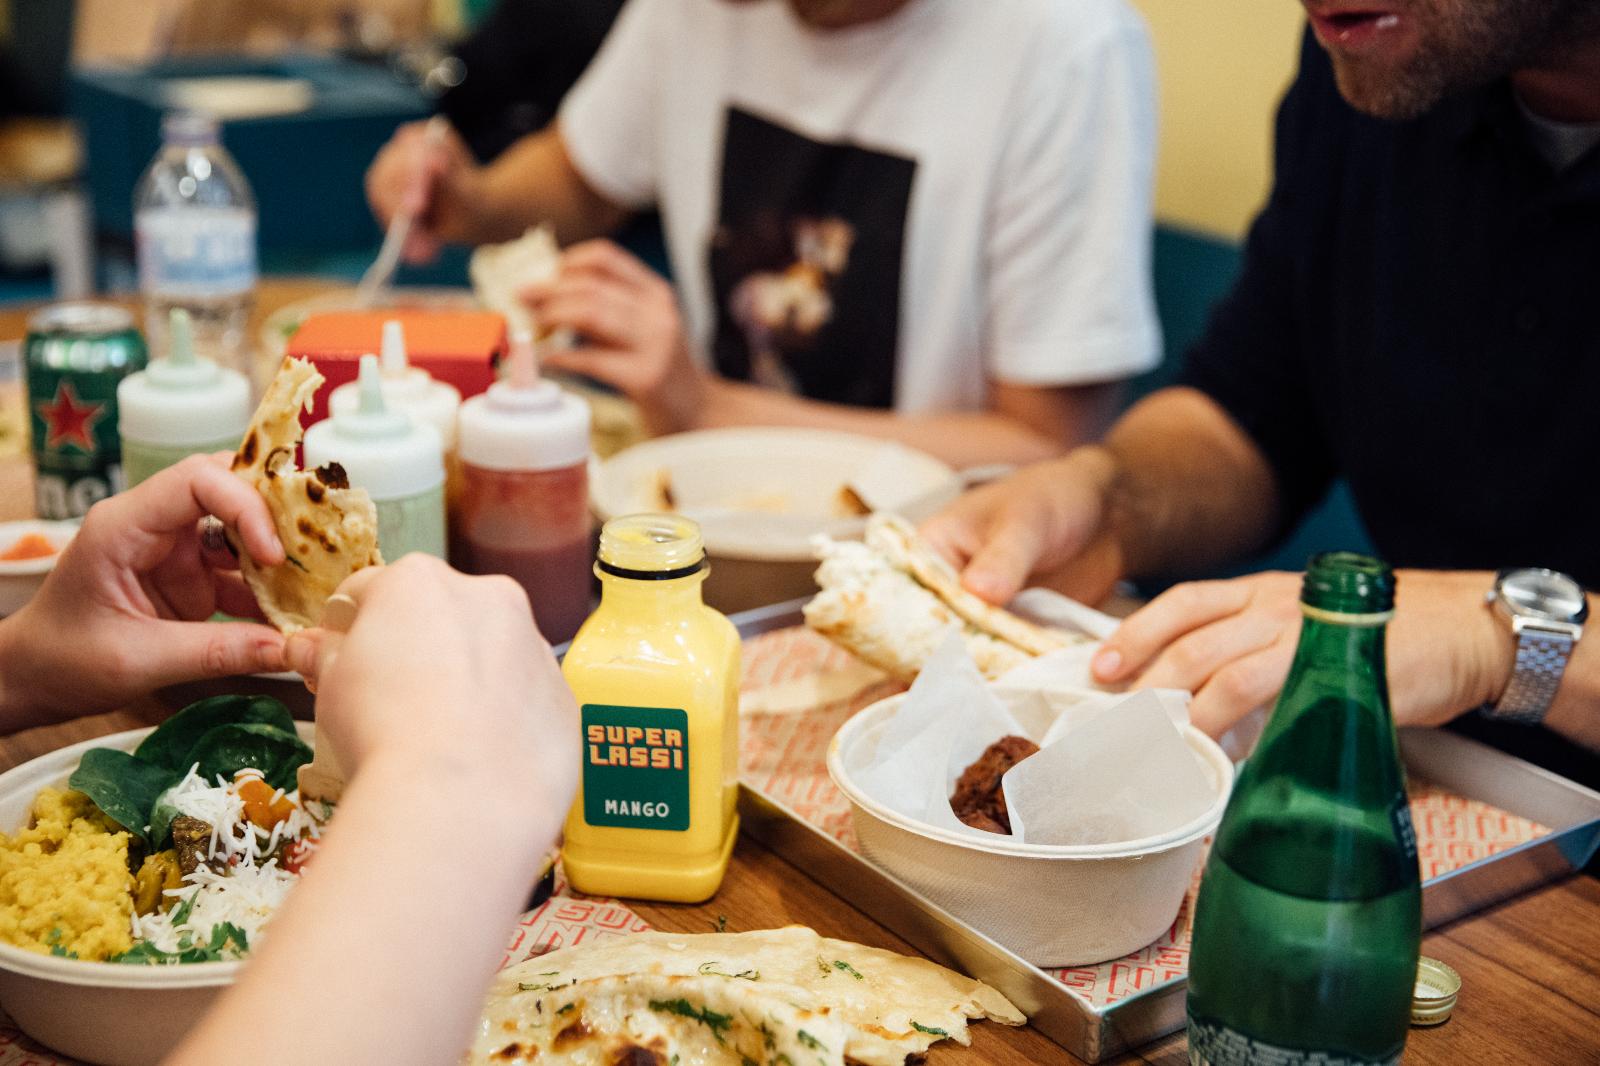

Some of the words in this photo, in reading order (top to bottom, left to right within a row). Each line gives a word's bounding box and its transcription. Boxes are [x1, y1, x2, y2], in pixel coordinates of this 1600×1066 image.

[587, 725, 683, 748] SUPER
[589, 745, 684, 770] LASSI
[604, 799, 670, 818] MANGO
